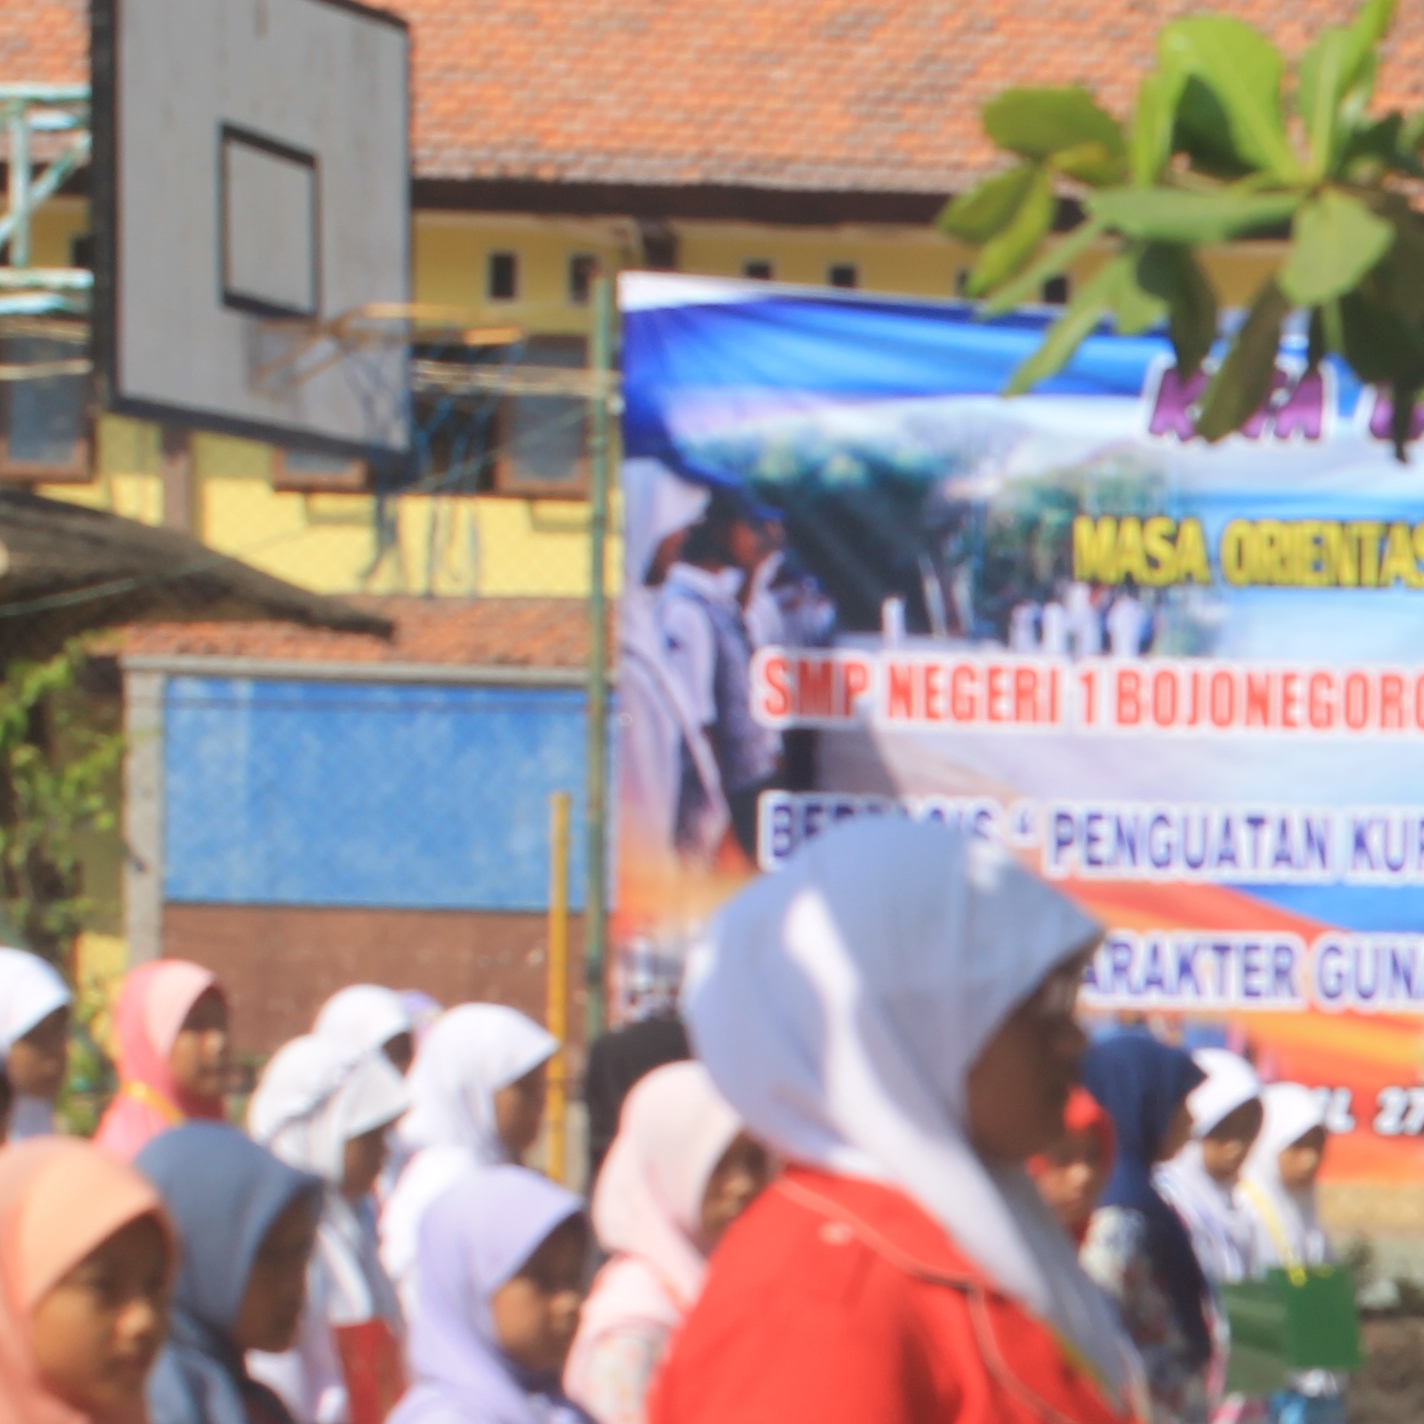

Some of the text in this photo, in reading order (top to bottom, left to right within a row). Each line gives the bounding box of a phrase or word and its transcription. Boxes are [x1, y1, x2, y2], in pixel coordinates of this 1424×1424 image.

[1072, 513, 1211, 587] MASA
[763, 657, 868, 718] SMP
[887, 663, 1059, 725] NEGERI
[1080, 669, 1096, 725] 1
[1054, 812, 1329, 870] PENGUATAN
[1083, 942, 1297, 999] RAKTER
